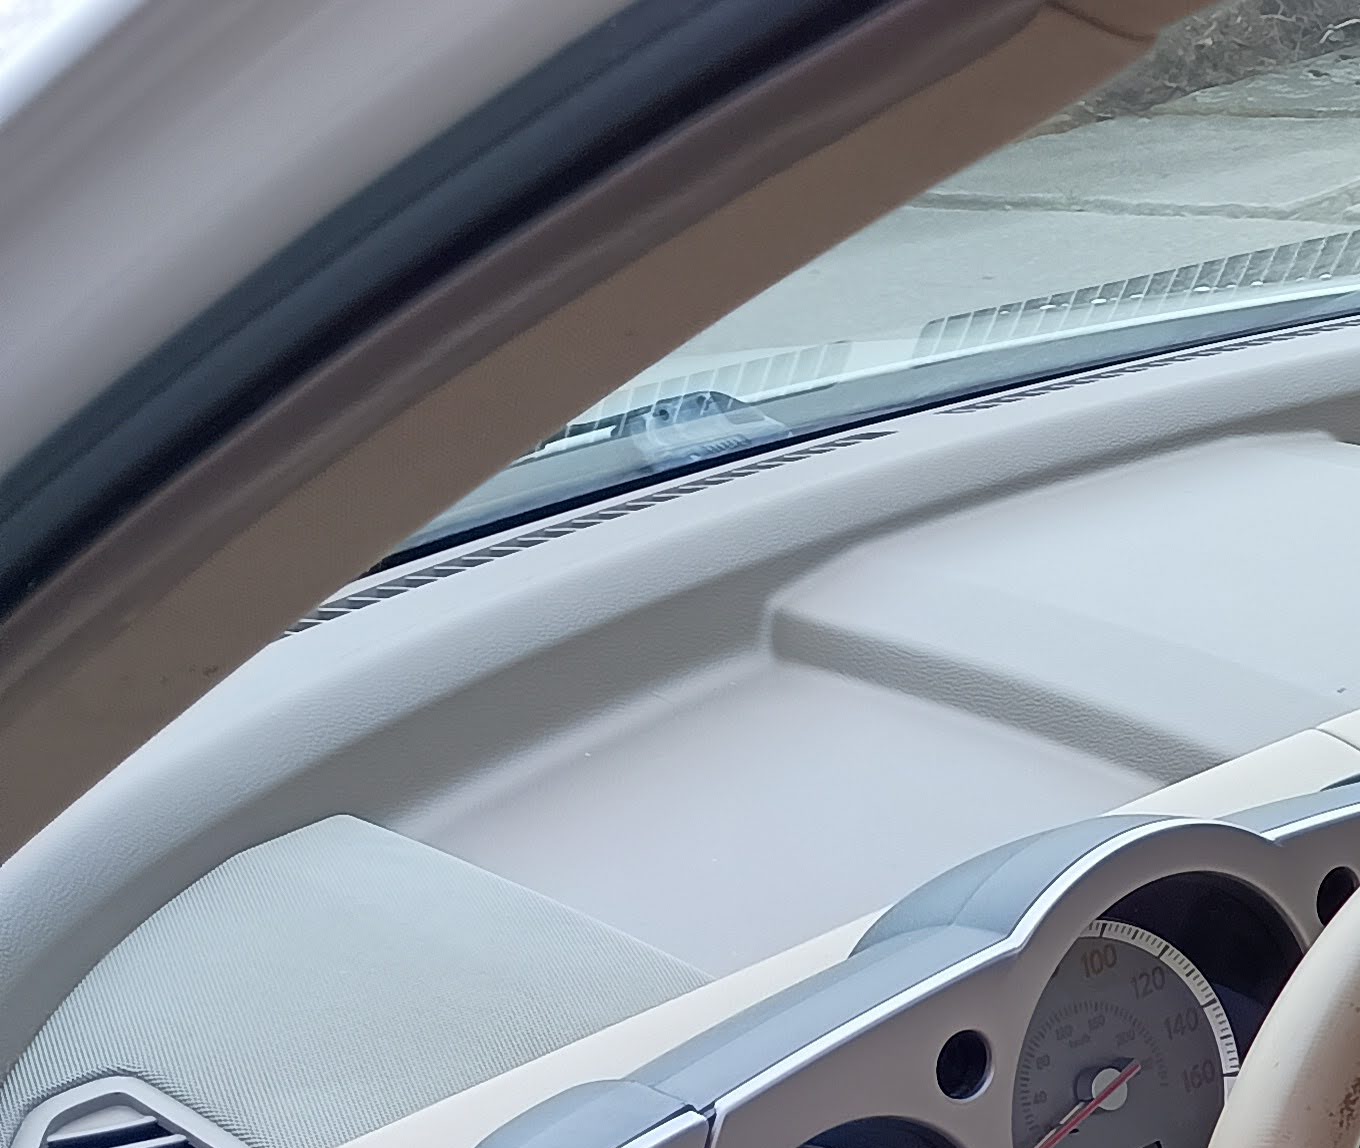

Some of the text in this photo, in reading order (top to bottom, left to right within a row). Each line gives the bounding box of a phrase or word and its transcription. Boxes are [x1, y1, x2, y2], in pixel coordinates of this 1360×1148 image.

[1080, 943, 1117, 978] 100
[1130, 966, 1166, 999] 120
[1164, 1007, 1199, 1040] 140
[1183, 1060, 1216, 1092] 160
